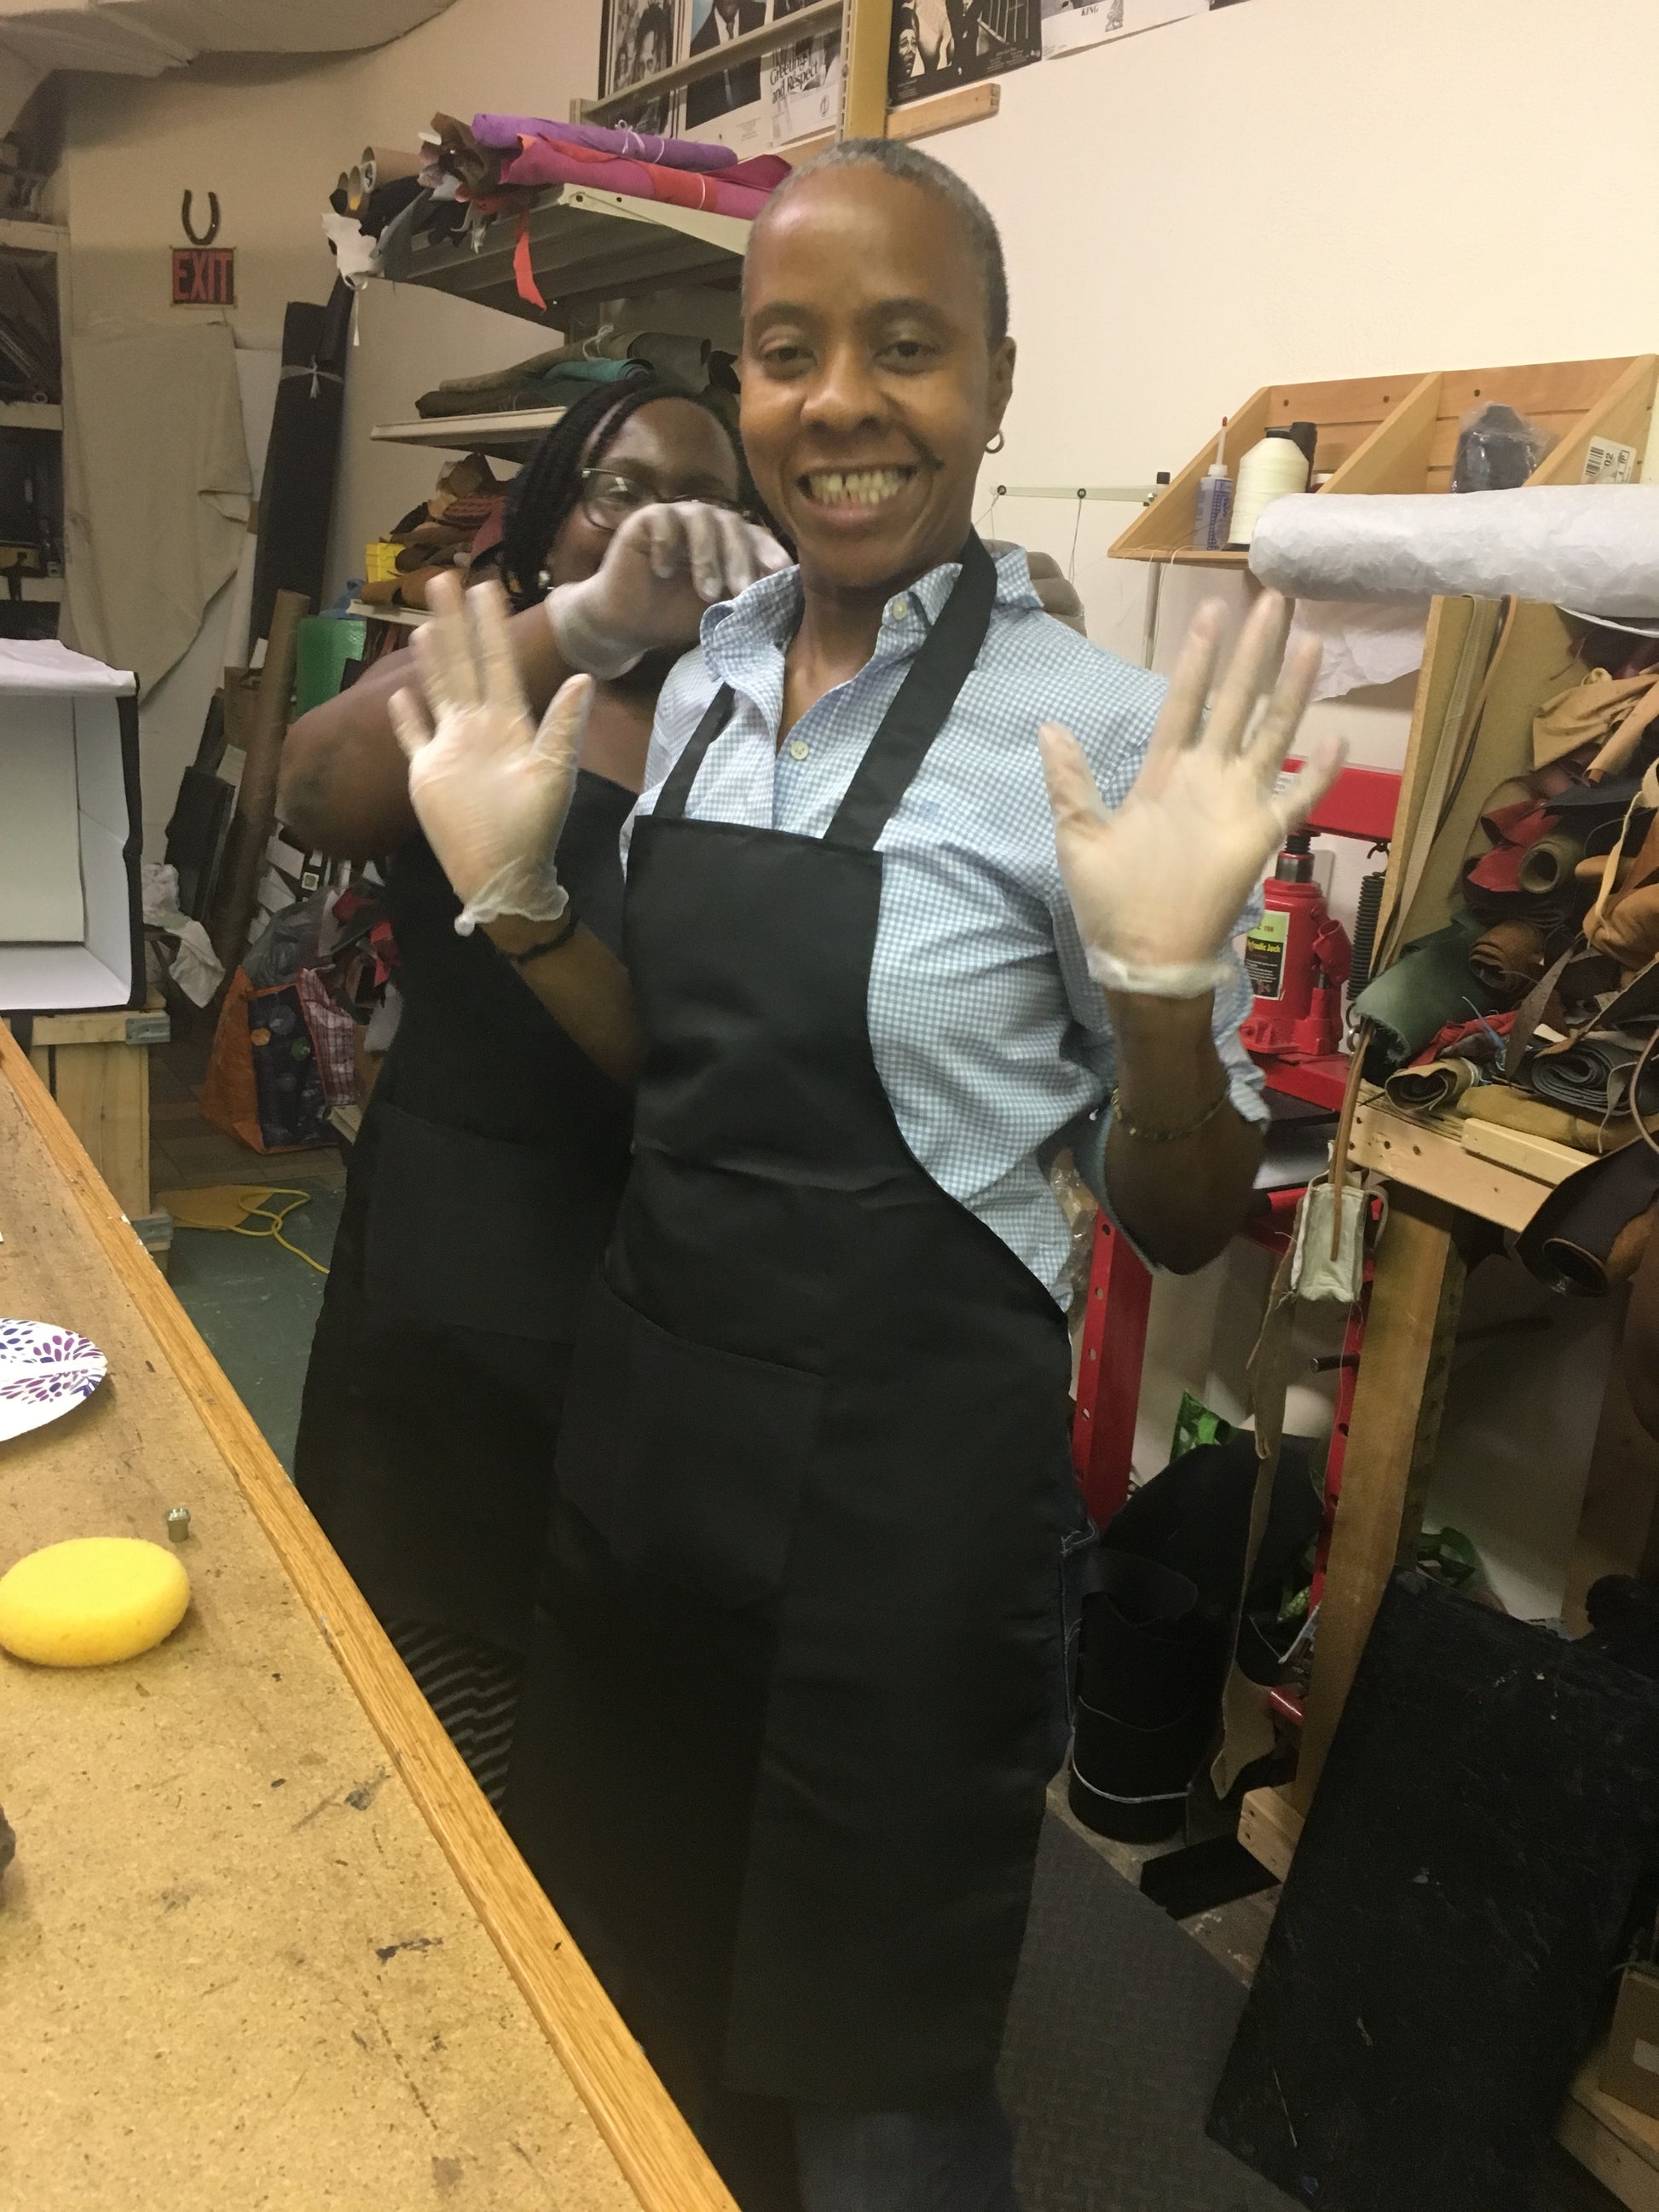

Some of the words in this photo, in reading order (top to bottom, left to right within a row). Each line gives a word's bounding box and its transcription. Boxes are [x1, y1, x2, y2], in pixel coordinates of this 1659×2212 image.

[1081, 5, 1099, 16] KING
[770, 52, 809, 85] Greetings
[772, 78, 785, 104] and
[787, 61, 818, 92] Respect
[174, 252, 232, 301] EXIT
